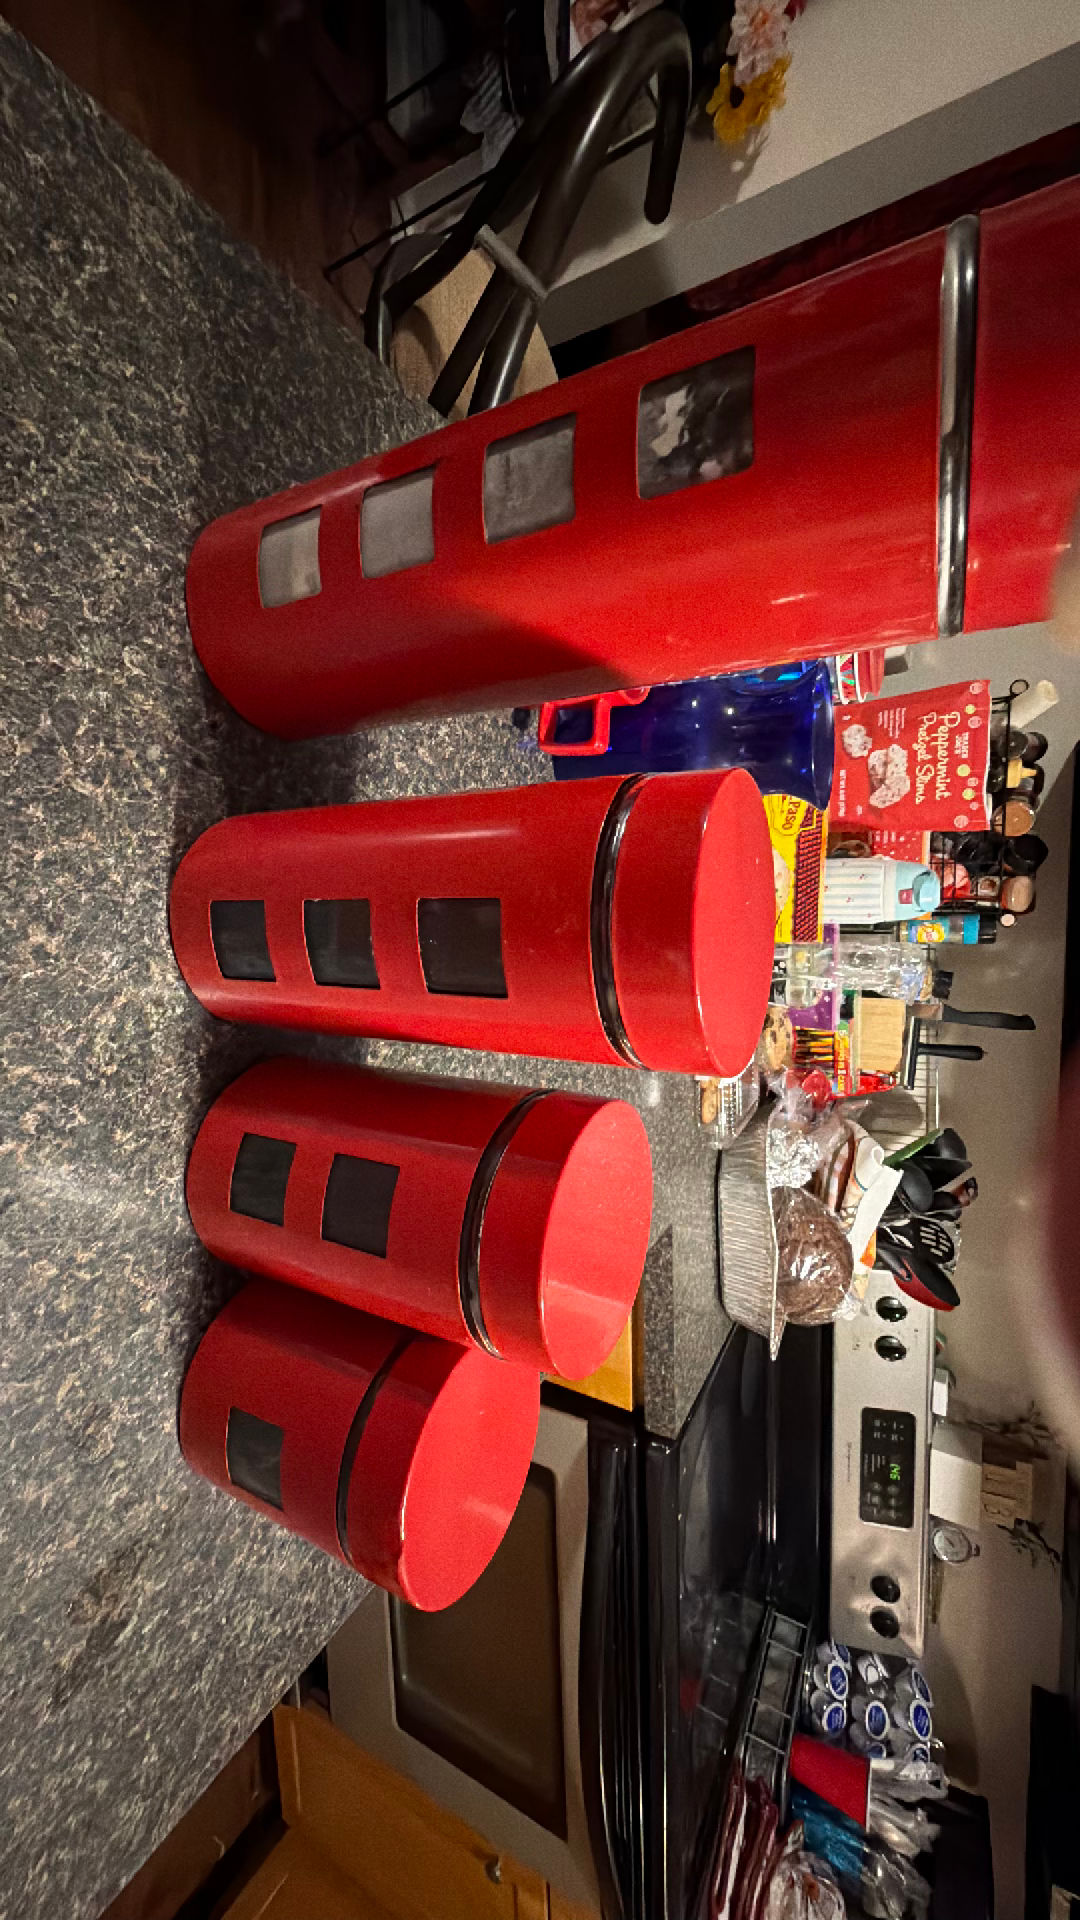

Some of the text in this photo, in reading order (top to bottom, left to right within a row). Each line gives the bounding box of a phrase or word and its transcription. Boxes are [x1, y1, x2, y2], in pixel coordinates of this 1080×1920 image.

[912, 712, 936, 804] Pretzel Slims
[930, 712, 960, 800] Peppermint
[782, 801, 800, 830] Paso
